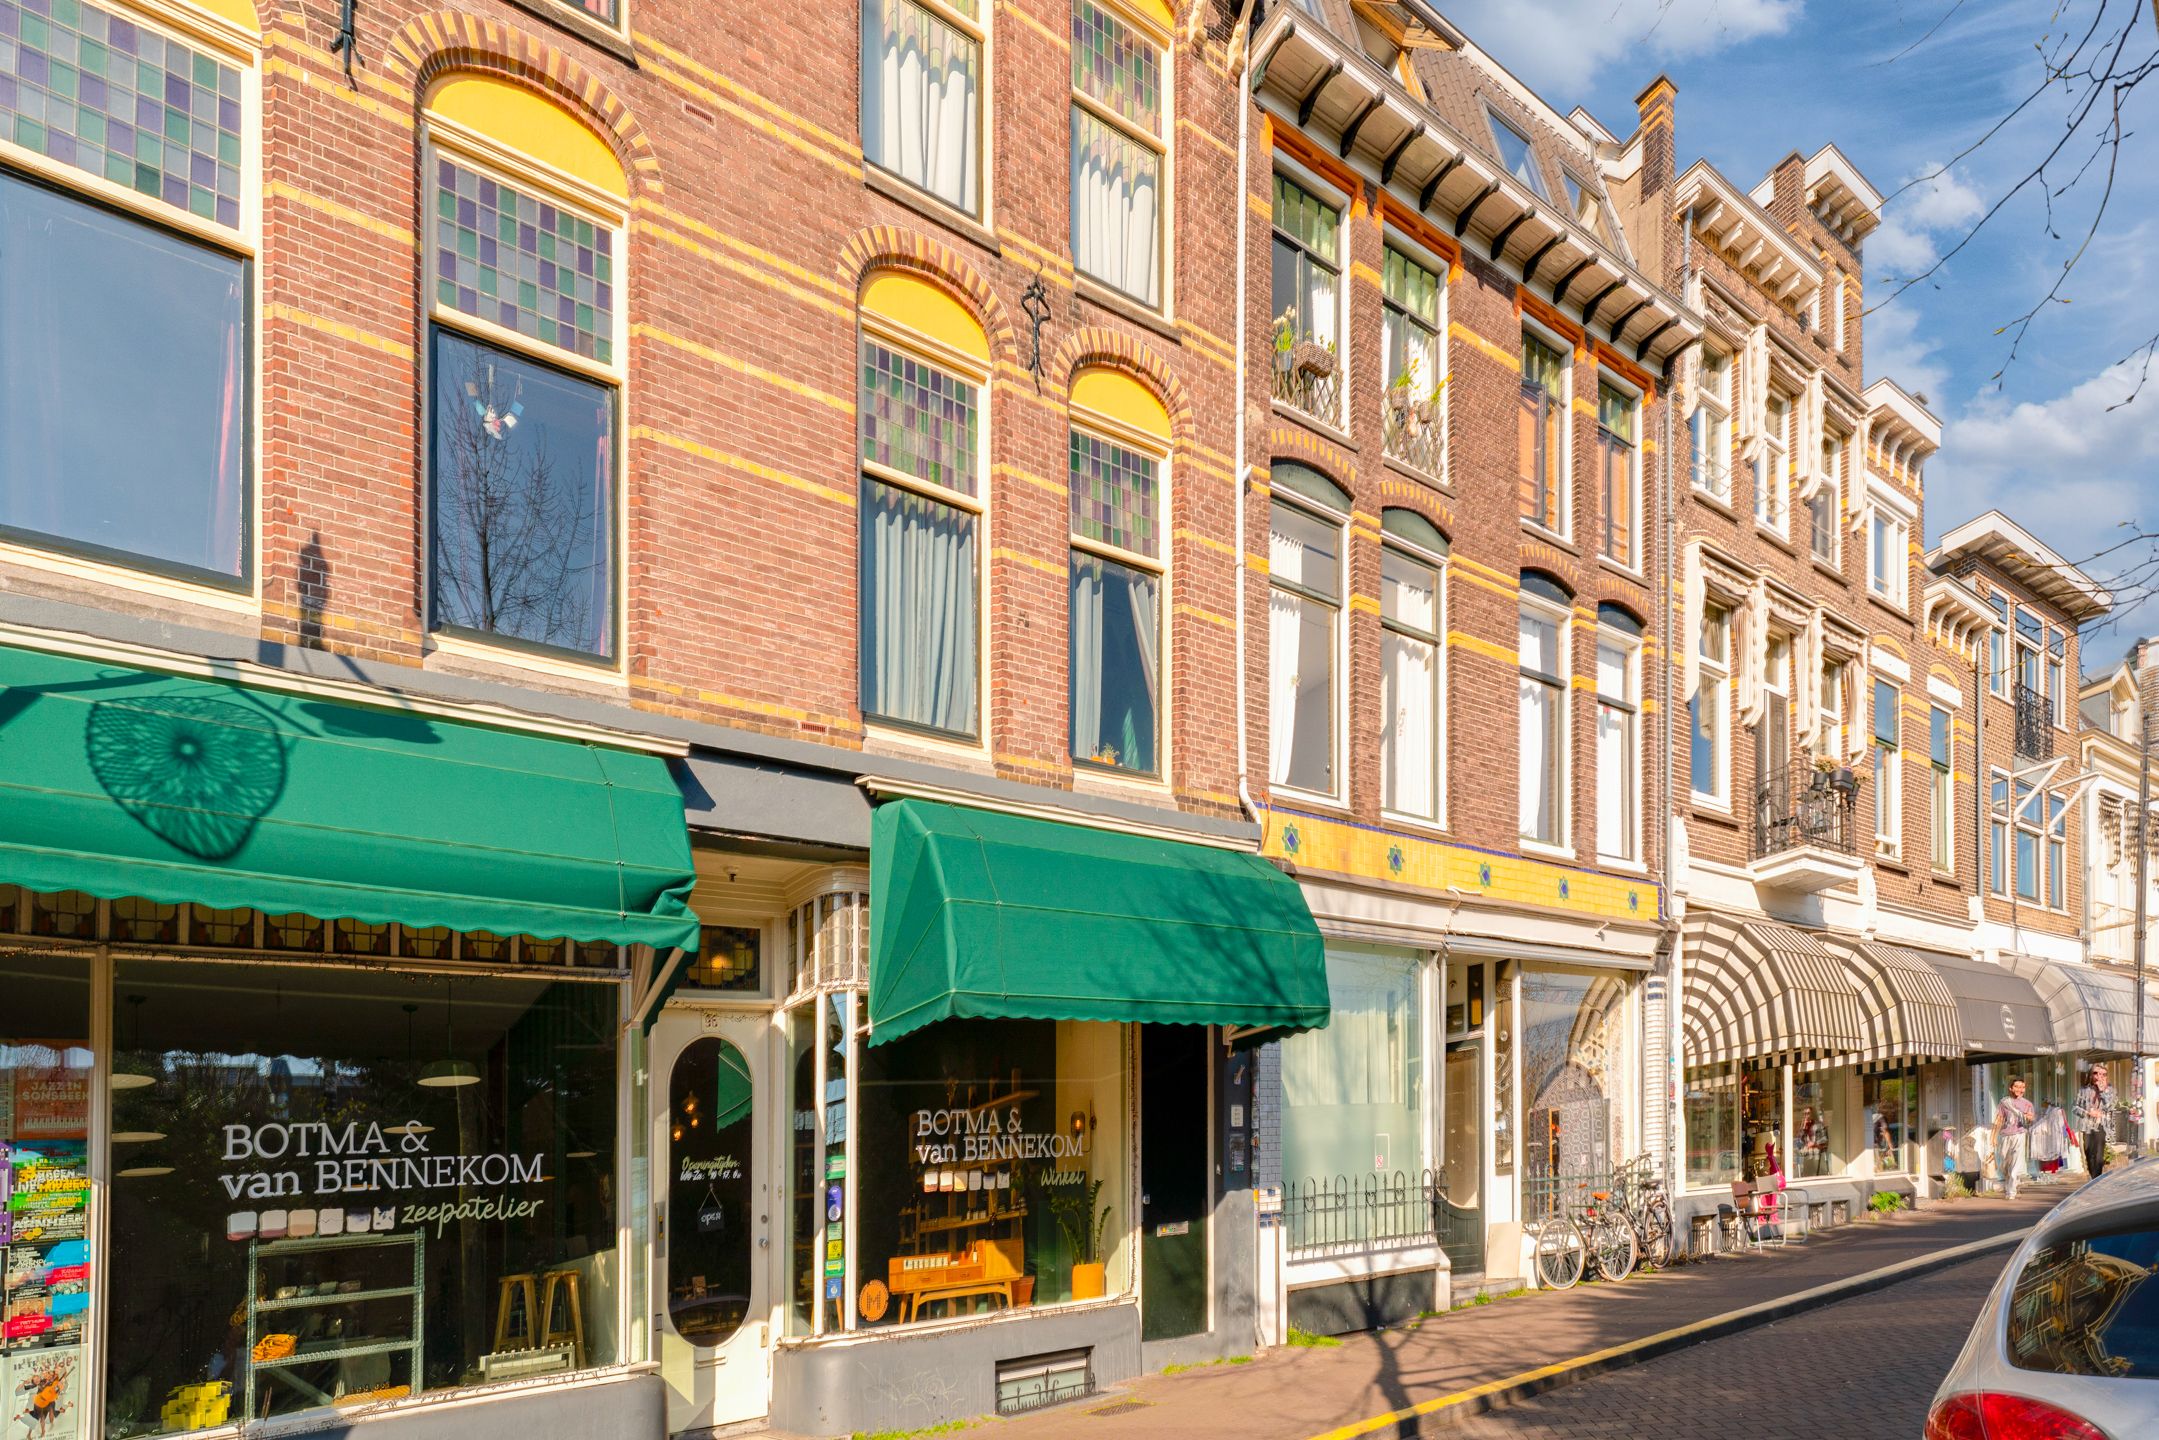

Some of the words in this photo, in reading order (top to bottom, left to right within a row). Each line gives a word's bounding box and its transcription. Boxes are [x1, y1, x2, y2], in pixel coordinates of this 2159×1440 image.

[221, 1121, 391, 1160] BOTMA
[400, 1119, 430, 1152] &
[917, 1109, 1003, 1137] BOTMA
[1007, 1106, 1023, 1134] &
[915, 1144, 958, 1164] van
[963, 1133, 1084, 1162] BENNEKOM
[218, 1170, 302, 1200] van
[314, 1153, 545, 1194] BENNEKOM
[402, 1194, 544, 1239] zeepatelier
